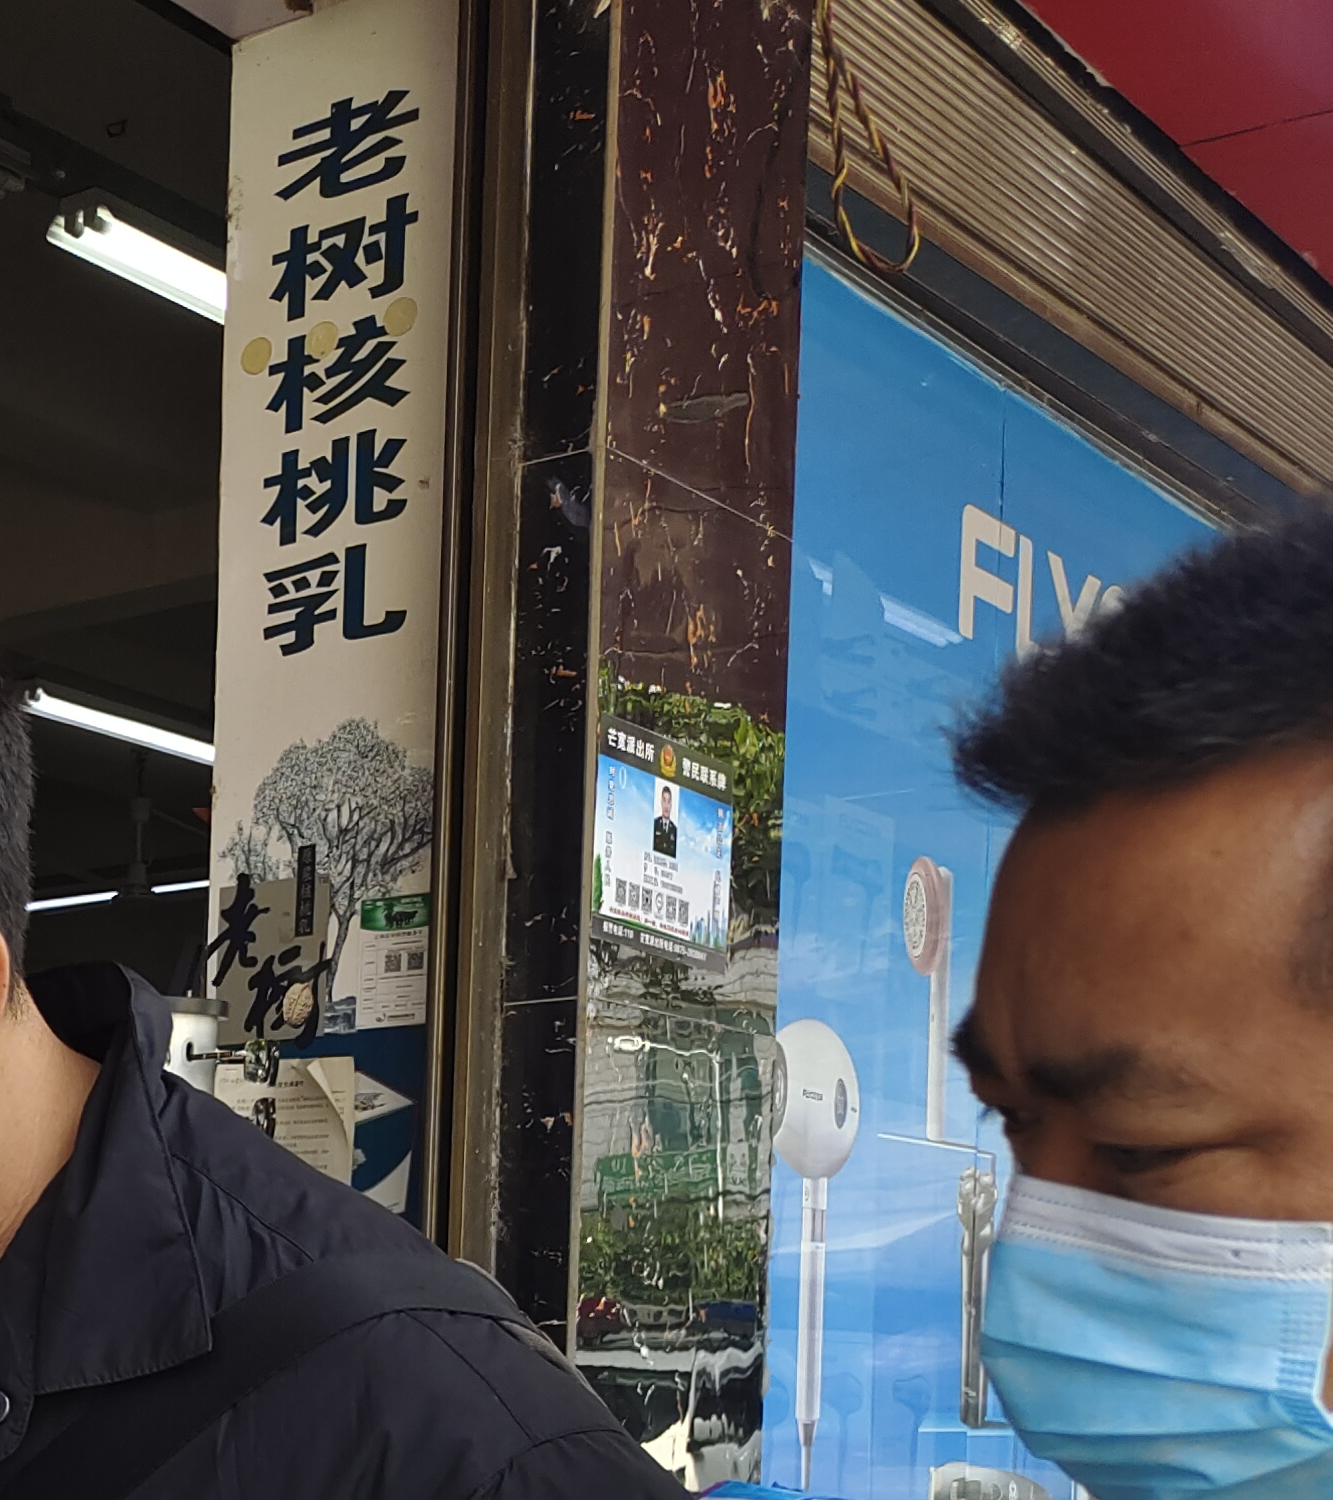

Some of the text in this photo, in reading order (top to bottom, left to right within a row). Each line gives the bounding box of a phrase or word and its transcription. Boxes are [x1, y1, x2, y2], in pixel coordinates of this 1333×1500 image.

[260, 90, 420, 656] 老树核桃乳
